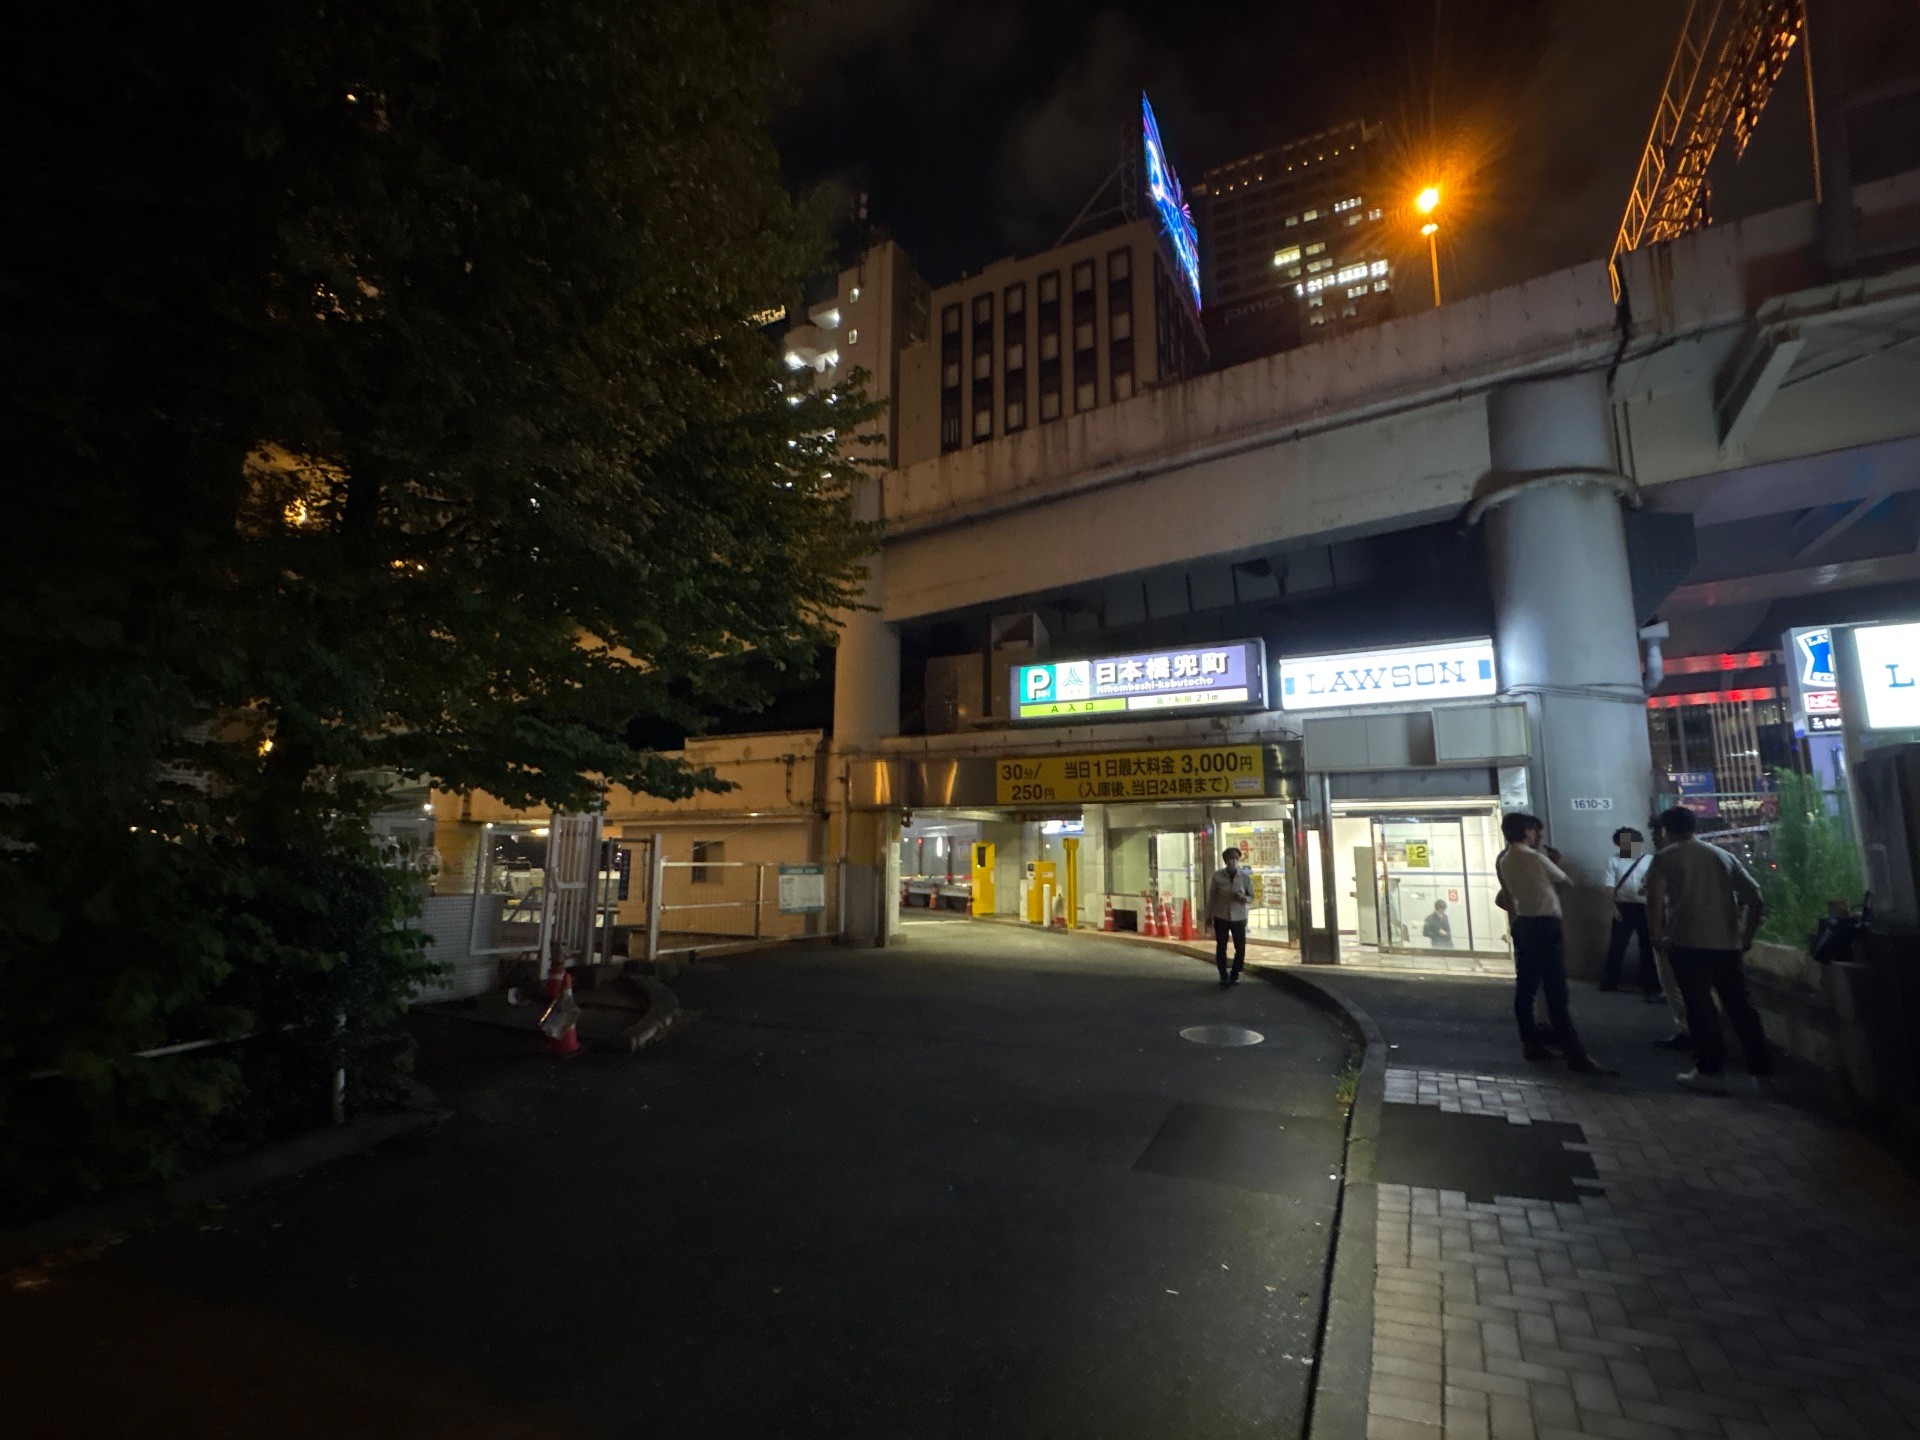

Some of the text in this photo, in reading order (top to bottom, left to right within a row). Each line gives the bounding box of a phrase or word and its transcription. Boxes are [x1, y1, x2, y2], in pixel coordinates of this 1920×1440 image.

[1096, 651, 1228, 685] 日本橋兜町
[1307, 660, 1467, 694] LAWSON
[1027, 668, 1051, 700] P
[1096, 677, 1213, 694] Nihombashi-kabutocho
[1065, 752, 1253, 779] 当日1日最大料金 3,000円
[1012, 784, 1056, 801] 250円
[1574, 798, 1610, 809] 1610-3
